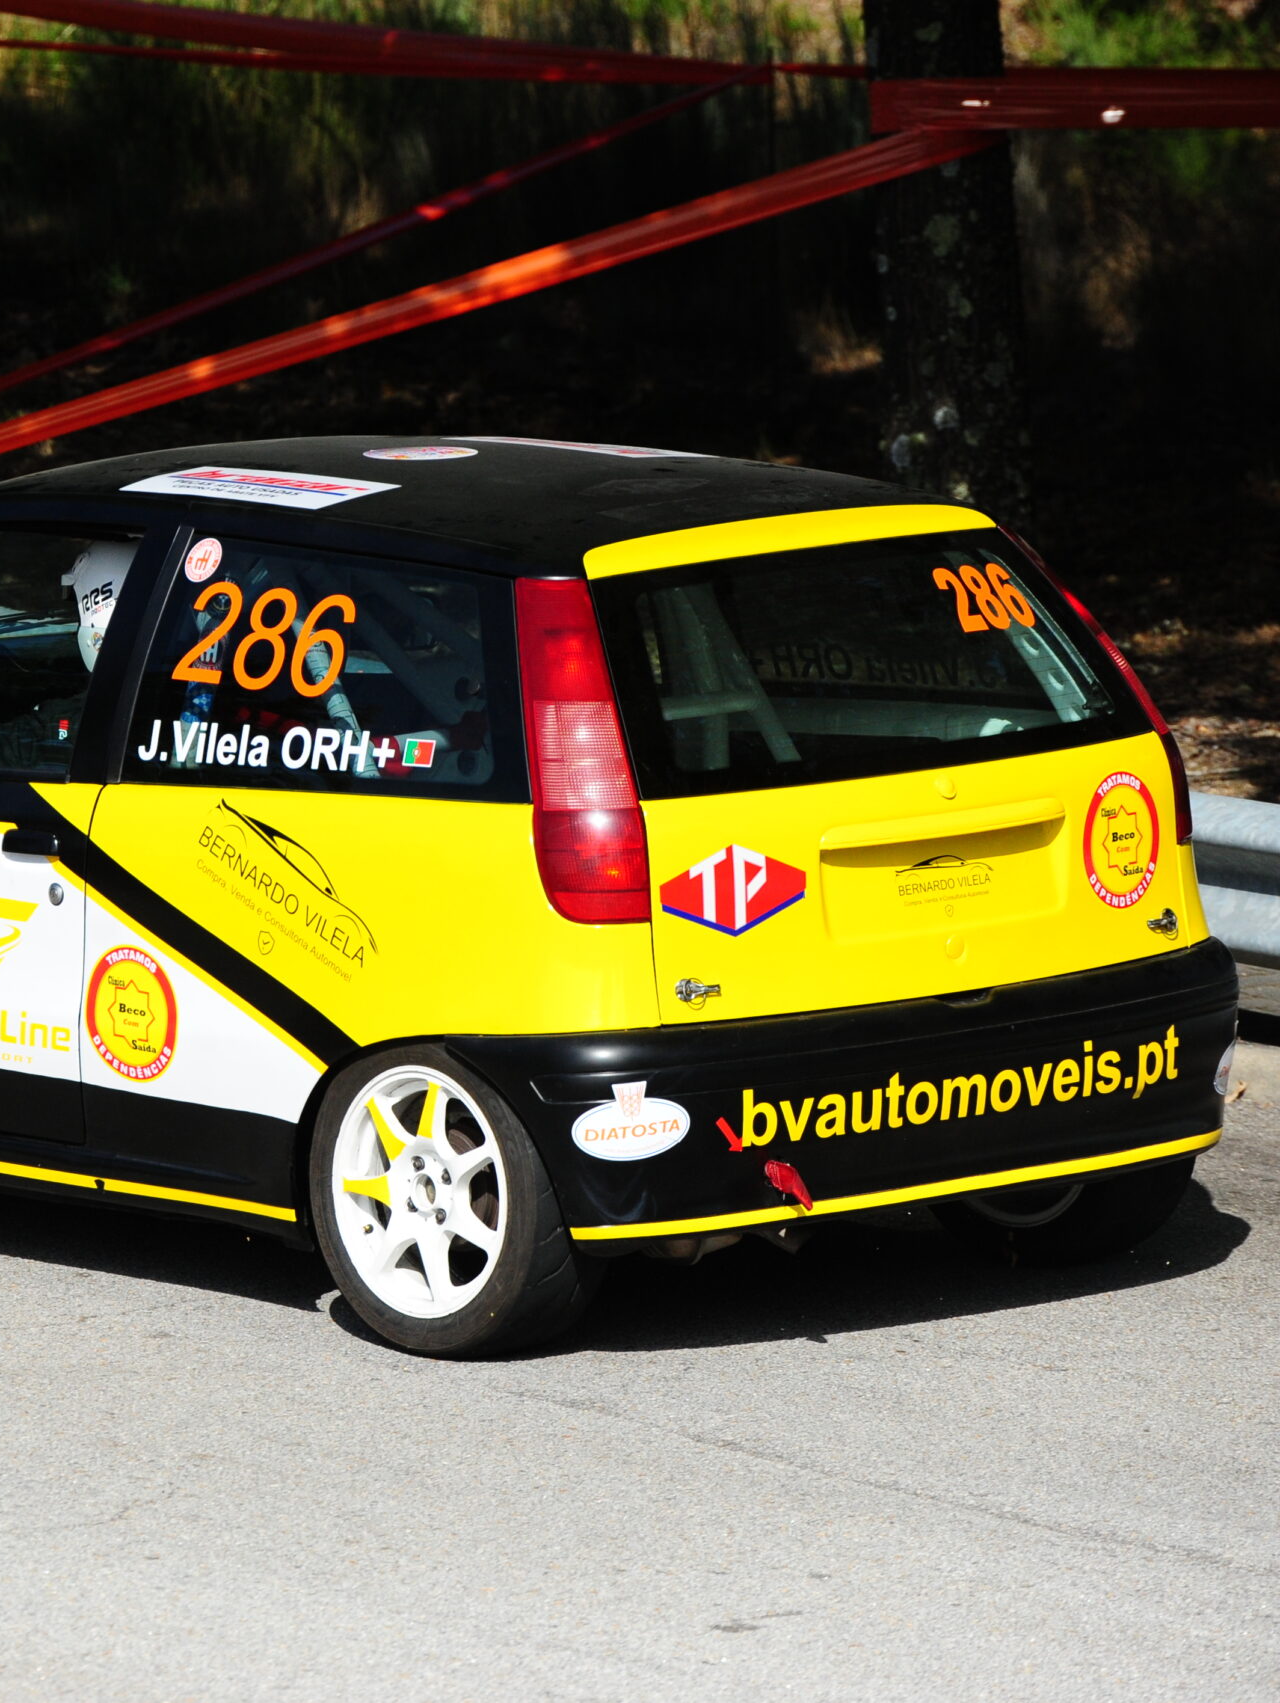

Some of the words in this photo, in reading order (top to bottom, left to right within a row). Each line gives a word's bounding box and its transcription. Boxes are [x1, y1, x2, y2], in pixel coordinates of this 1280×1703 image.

[932, 563, 1036, 632] 286
[171, 581, 356, 698] 286
[138, 719, 270, 767] J.Vilela
[1097, 773, 1141, 797] TRATAMOS
[1112, 832, 1136, 843] Beco
[198, 825, 299, 915] BERNARDO
[304, 904, 365, 968] VILELA
[229, 884, 256, 911] Venda
[256, 906, 264, 917] e
[898, 878, 956, 897] BERNARDO
[957, 873, 991, 887] VILELA
[1089, 861, 1156, 908] DEPENDÊNCIAS
[105, 949, 157, 974] TRATAMOS
[119, 1003, 146, 1017] Beco
[93, 1034, 172, 1079] DEPENDÊNCIAS
[740, 1024, 1181, 1148] bvautomoveis.pt
[584, 1118, 681, 1142] DIATOSTA
